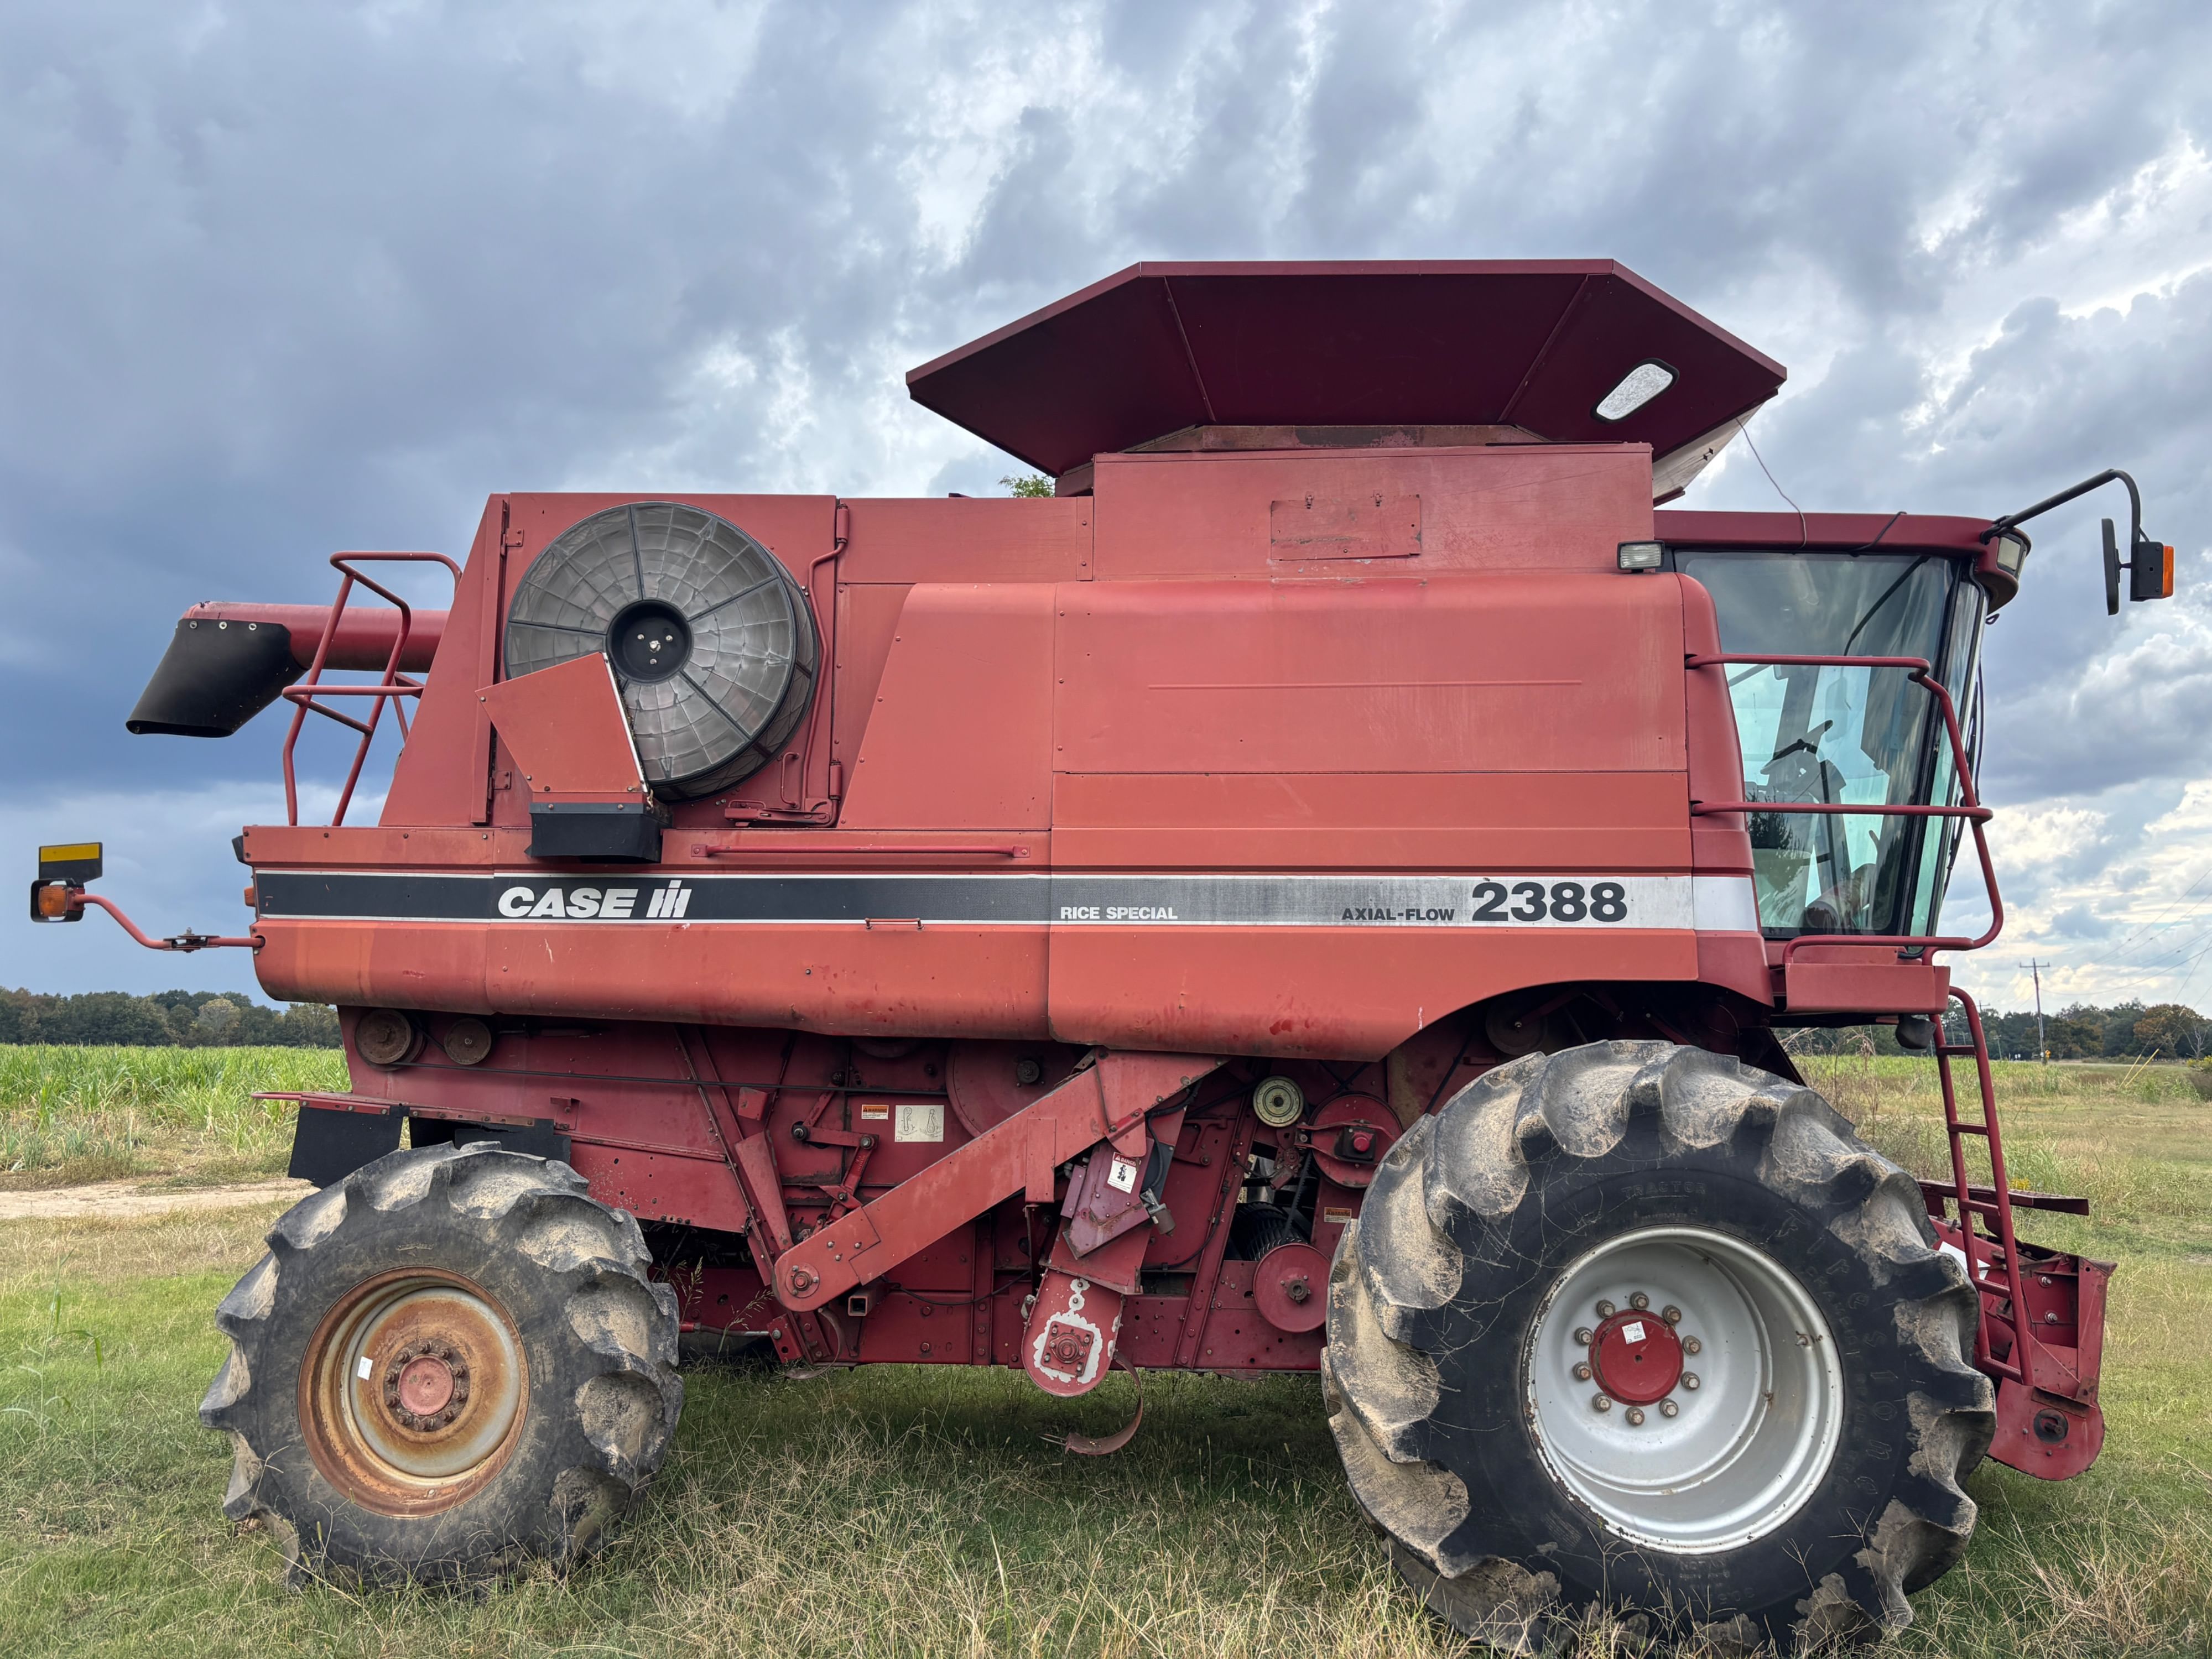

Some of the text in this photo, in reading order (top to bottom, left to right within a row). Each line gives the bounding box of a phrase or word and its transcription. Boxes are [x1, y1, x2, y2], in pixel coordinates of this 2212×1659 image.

[498, 886, 638, 918] CASE
[1471, 881, 1627, 922] 2388
[1060, 906, 1178, 920] RICE SPECIAL
[1341, 907, 1455, 921] AXIAL-FLOW
[1620, 1181, 1706, 1198] TRACTOR
